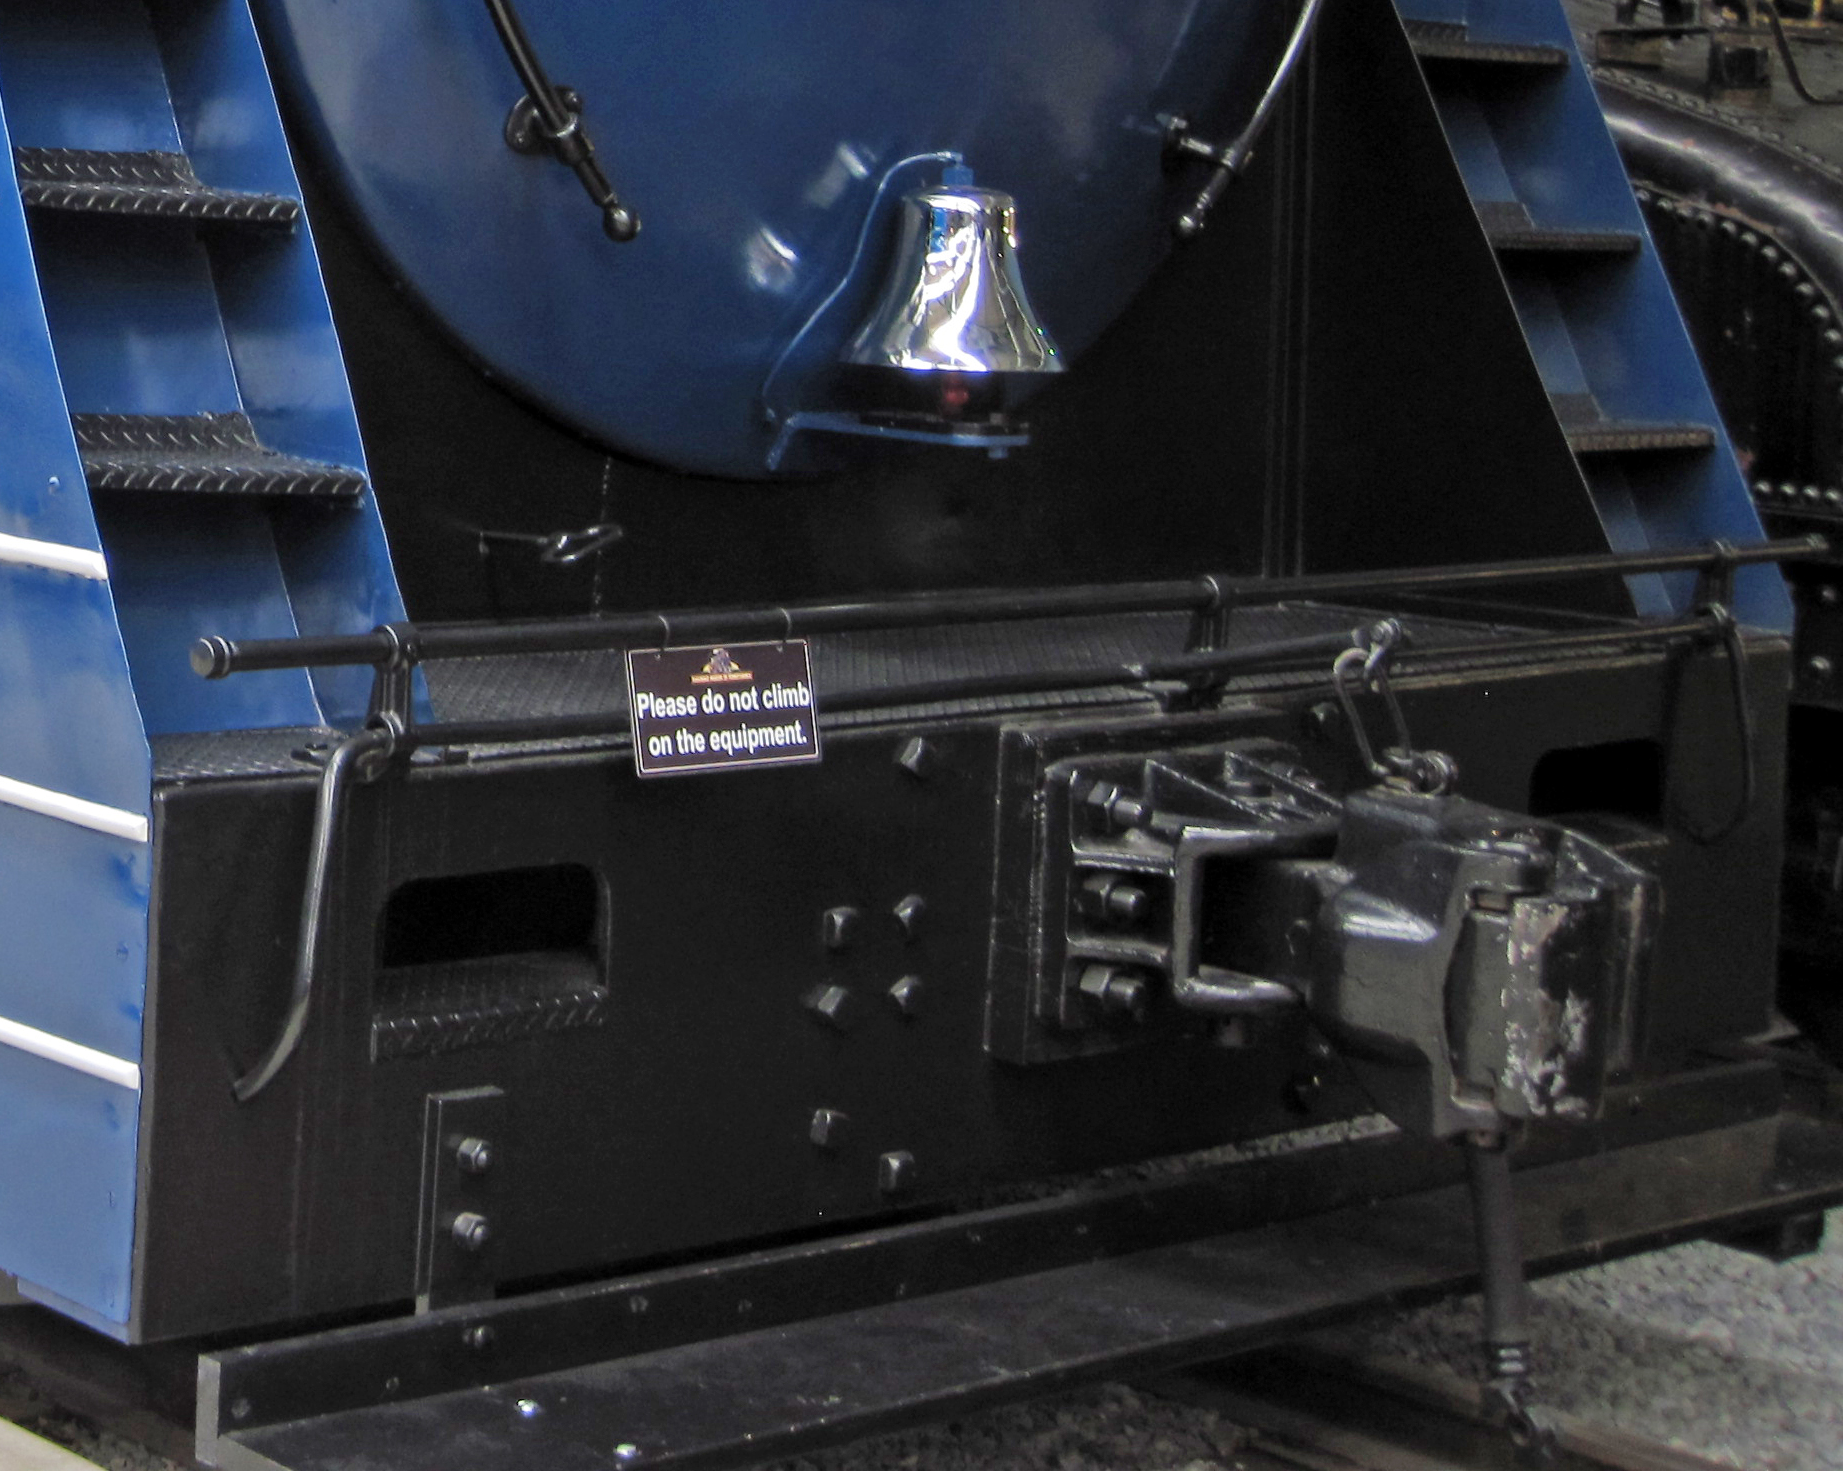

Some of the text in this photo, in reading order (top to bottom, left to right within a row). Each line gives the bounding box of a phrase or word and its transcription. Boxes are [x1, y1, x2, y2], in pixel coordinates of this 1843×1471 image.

[636, 681, 810, 720] Please do not climb
[648, 720, 808, 757] on the equipment.
